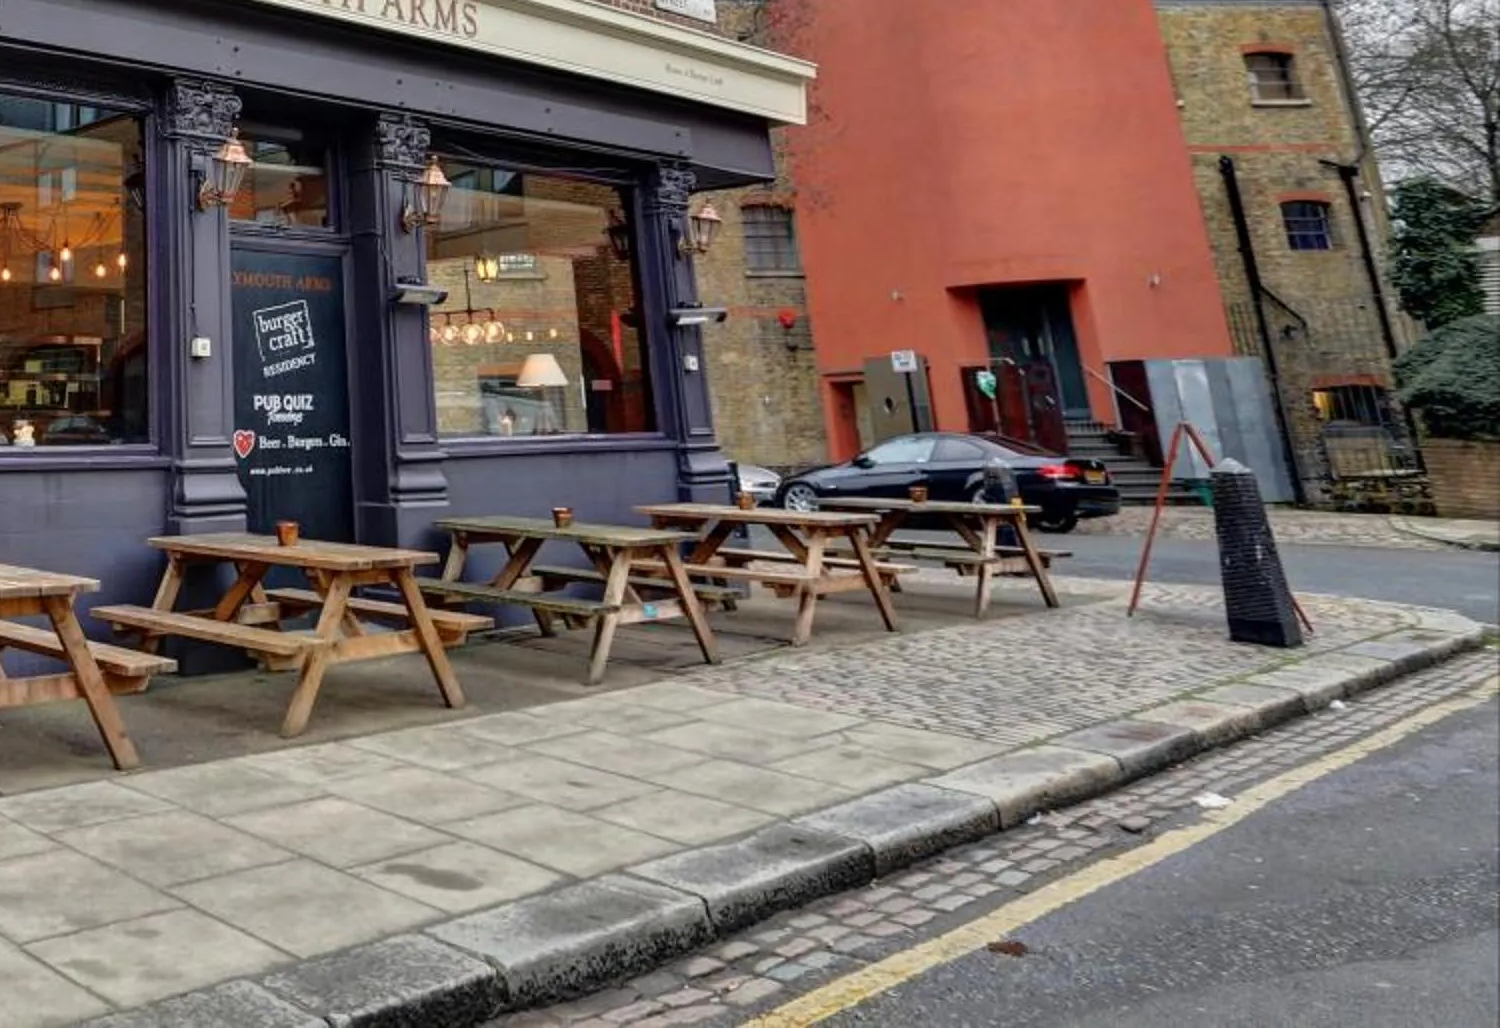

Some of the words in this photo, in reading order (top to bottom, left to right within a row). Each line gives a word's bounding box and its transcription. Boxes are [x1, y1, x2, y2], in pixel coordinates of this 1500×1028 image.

[269, 322, 306, 351] craft
[253, 394, 281, 412] PUB
[283, 394, 315, 412] QUIZ
